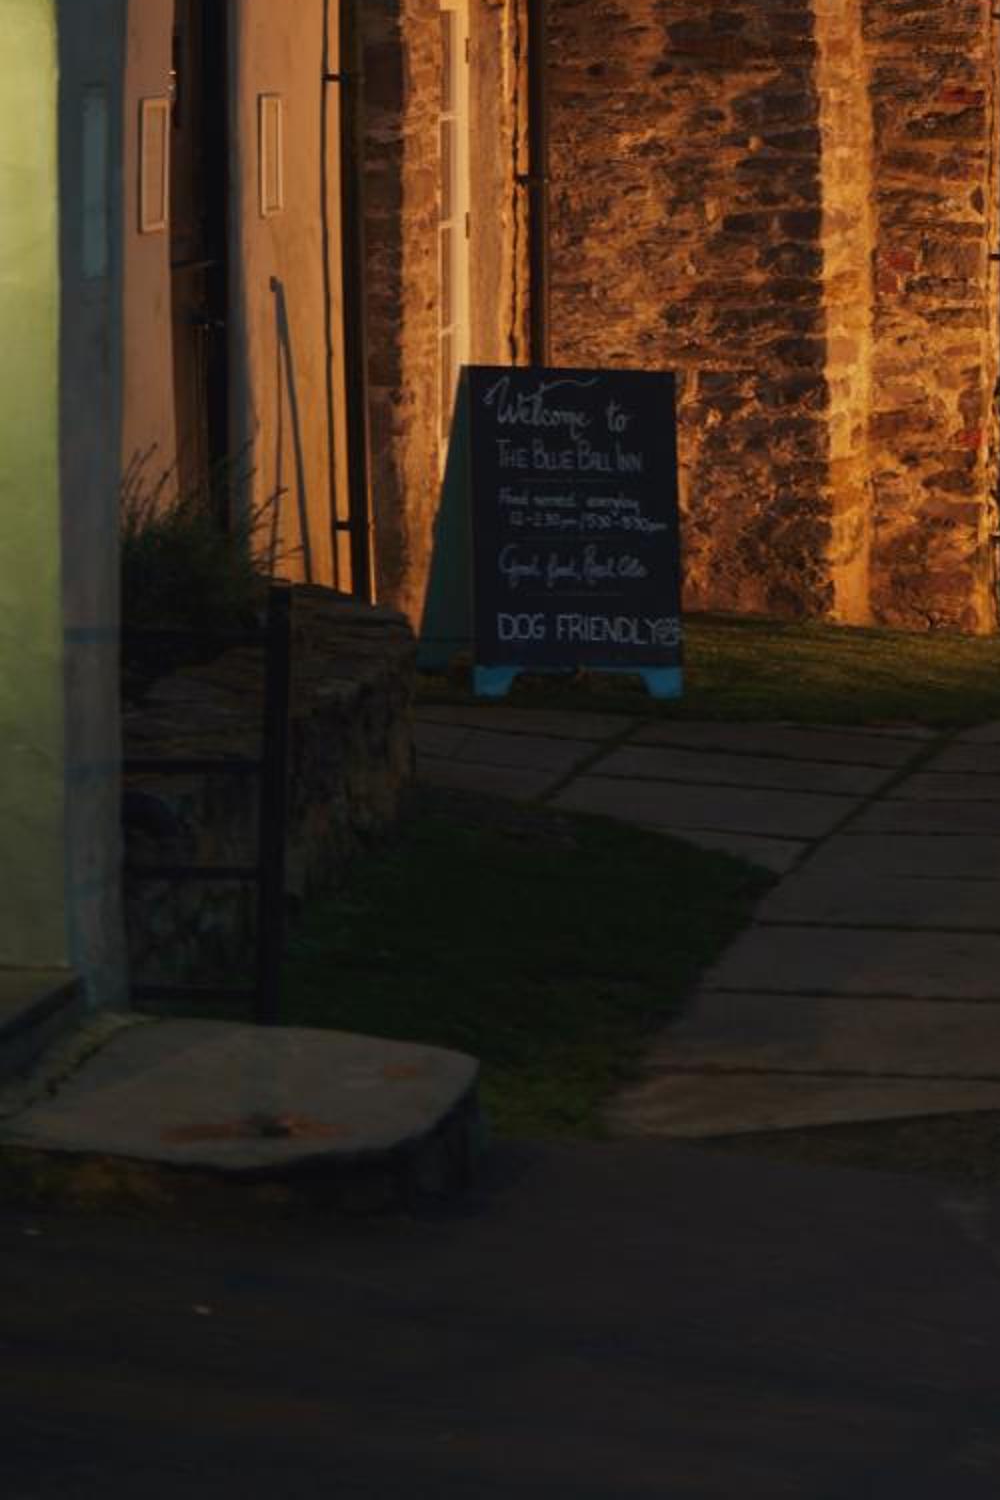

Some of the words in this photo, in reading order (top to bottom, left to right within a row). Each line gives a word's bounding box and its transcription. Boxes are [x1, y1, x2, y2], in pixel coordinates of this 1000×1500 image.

[482, 375, 600, 440] Welcome
[606, 397, 630, 433] to
[496, 439, 528, 469] THE
[532, 438, 574, 471] BLUE
[577, 439, 613, 472] BALL
[497, 611, 545, 641] DOG
[556, 612, 663, 645] FRIENDLY
